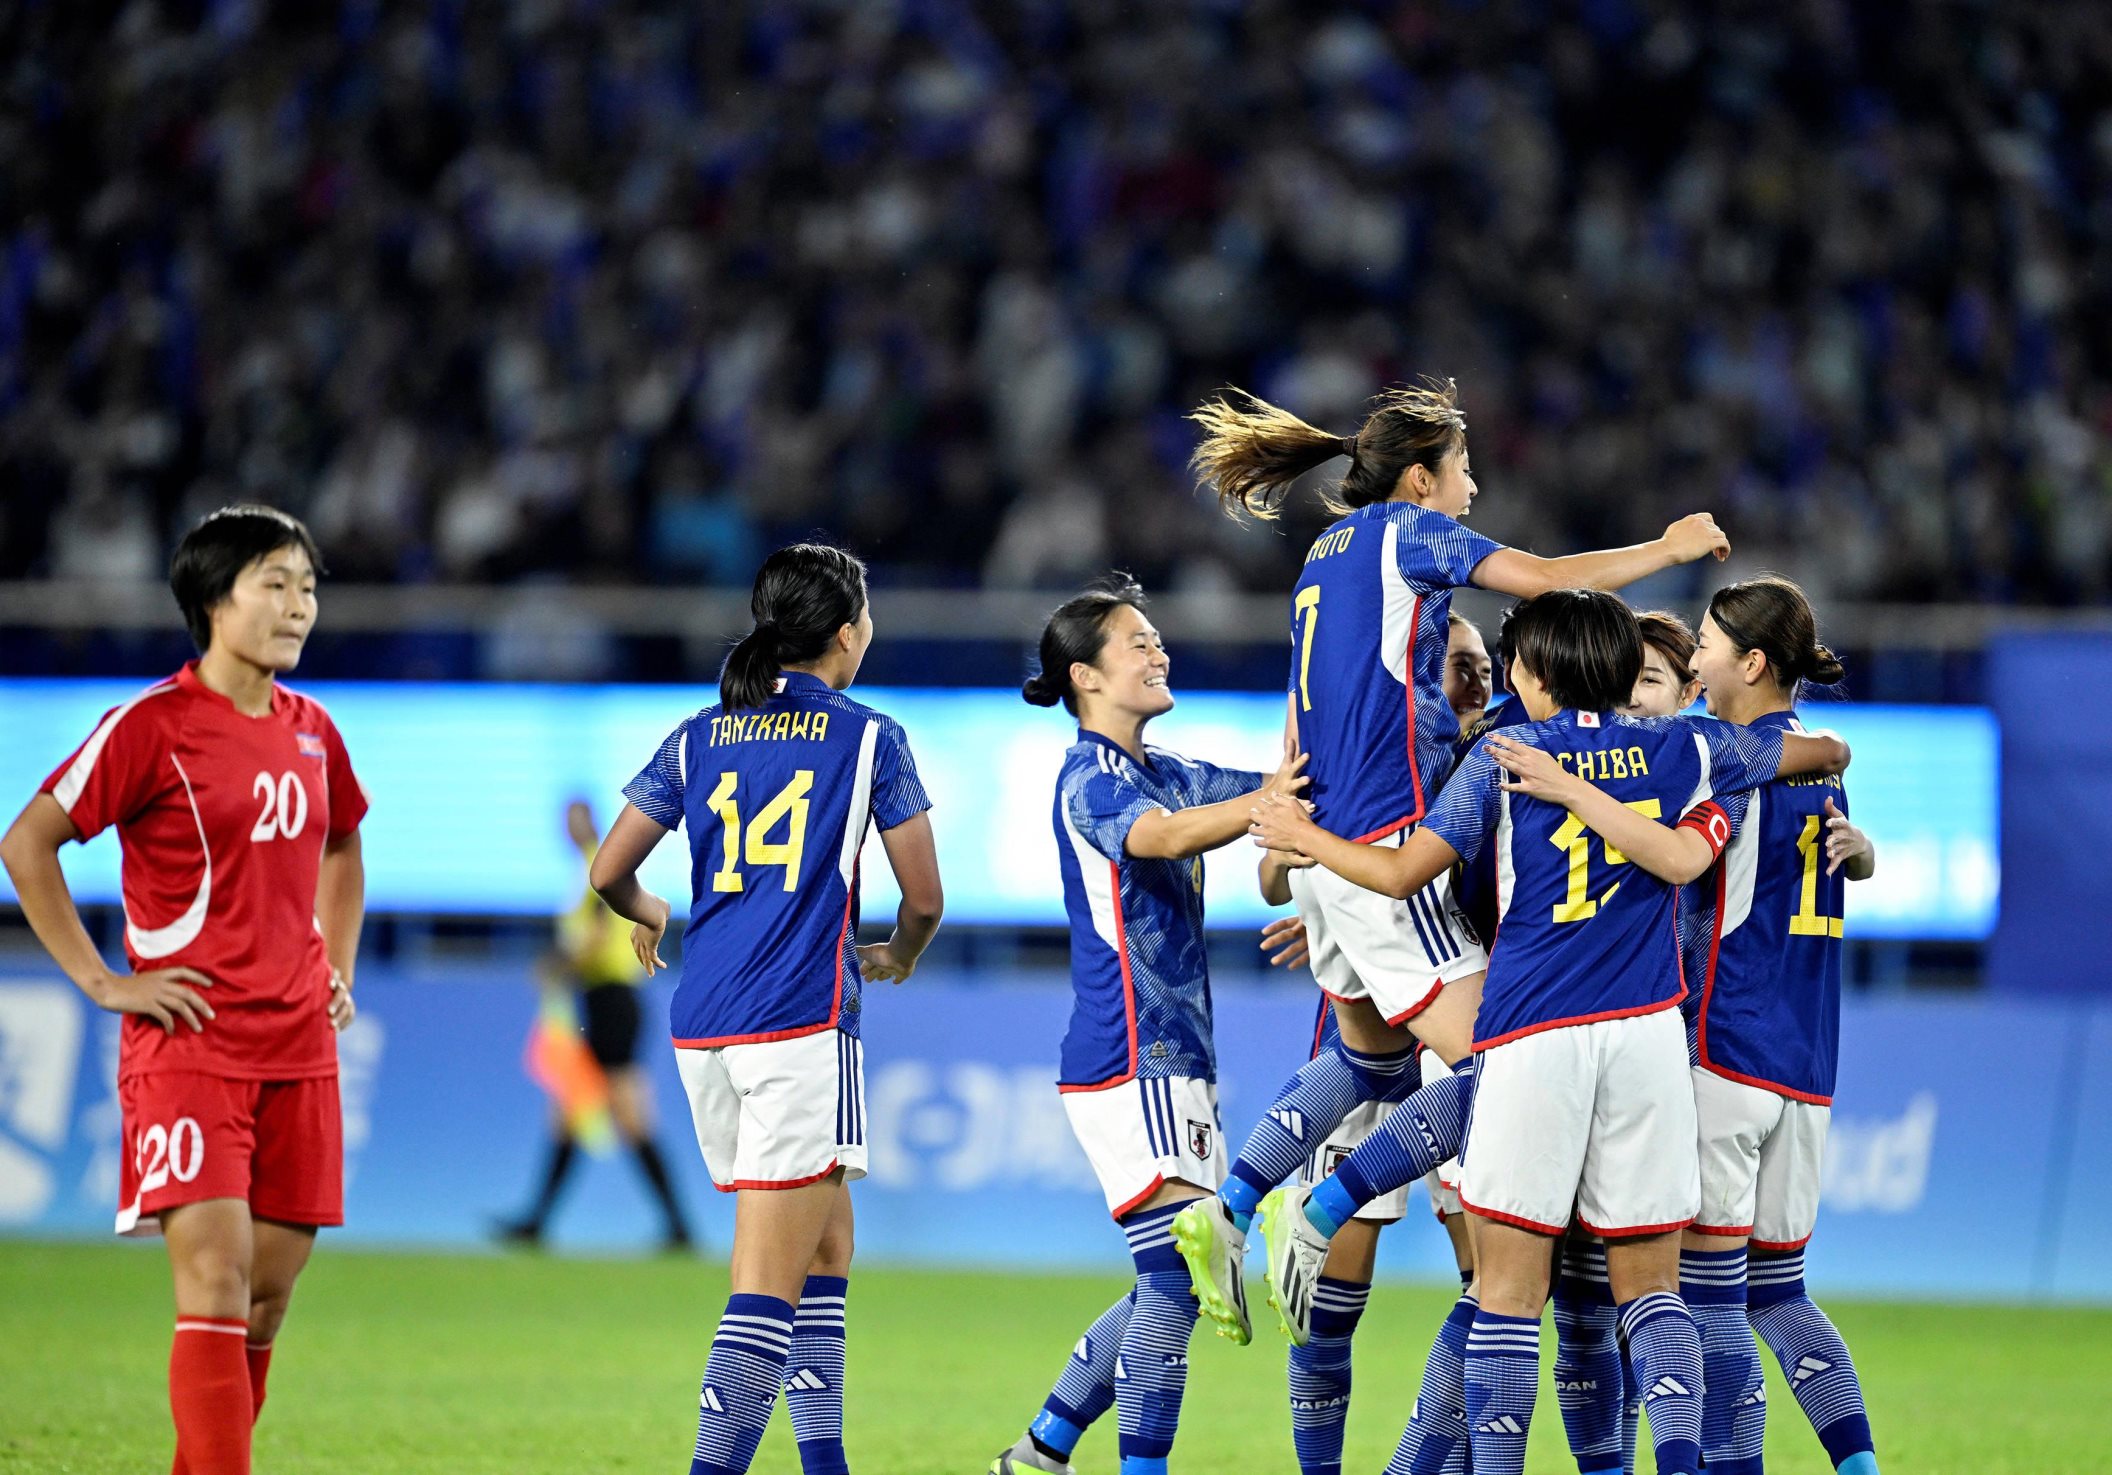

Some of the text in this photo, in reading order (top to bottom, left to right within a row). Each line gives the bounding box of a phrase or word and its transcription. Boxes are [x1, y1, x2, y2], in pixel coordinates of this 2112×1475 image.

[1295, 585, 1320, 712] 7
[709, 711, 829, 747] TANIKAWA
[1557, 746, 1649, 780] CHIBA
[250, 770, 308, 842] 20
[706, 769, 814, 892] 14
[1789, 815, 1844, 939] 1
[140, 1116, 204, 1194] 20
[1415, 1117, 1444, 1166] JAP
[1291, 1394, 1351, 1410] JAPAN
